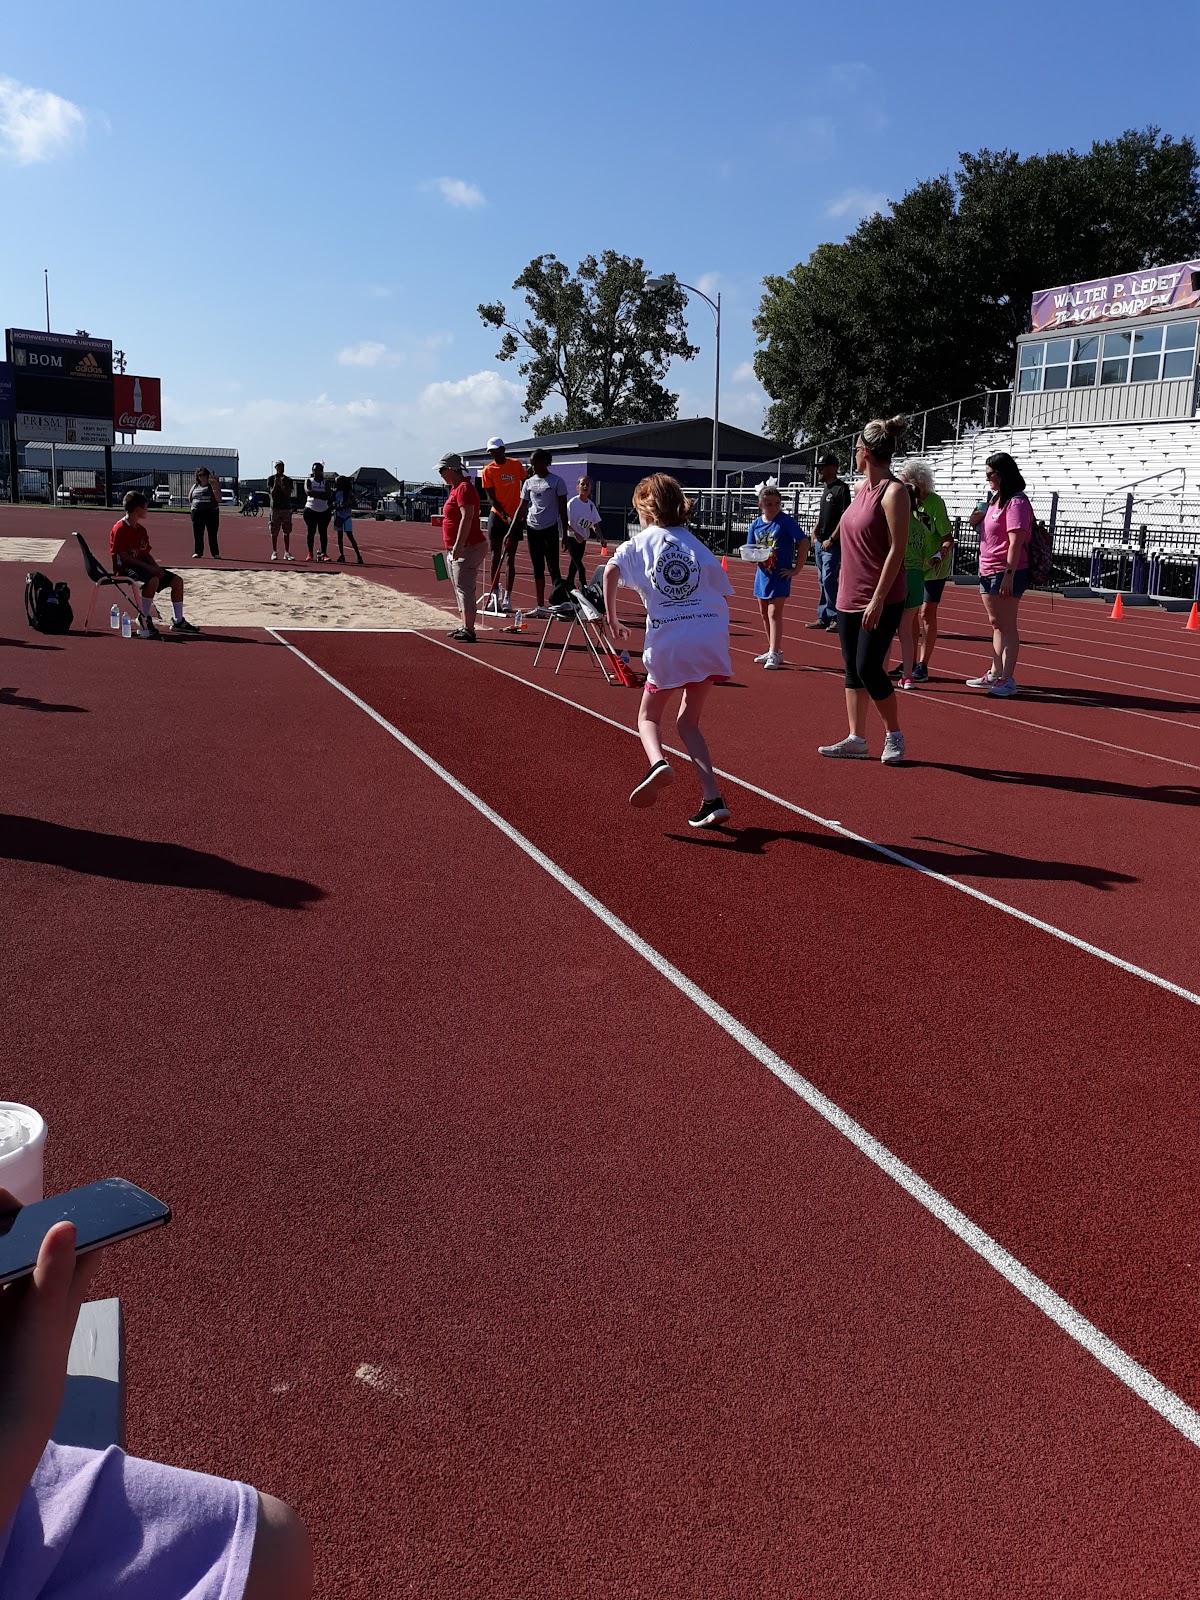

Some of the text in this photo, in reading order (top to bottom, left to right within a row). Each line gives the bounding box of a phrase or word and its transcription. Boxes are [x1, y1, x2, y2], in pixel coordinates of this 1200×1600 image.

[1053, 272, 1181, 309] WALTER P. LEDET
[1055, 292, 1173, 325] TRACK COMPLEX
[14, 332, 59, 343] NORTHWESTERN
[78, 340, 111, 349] UNIVERSITY
[28, 353, 63, 367] BOM
[75, 364, 102, 374] adidas
[23, 416, 61, 428] PRISM
[656, 552, 698, 573] GOVERNOR'S
[663, 582, 691, 595] GAMES
